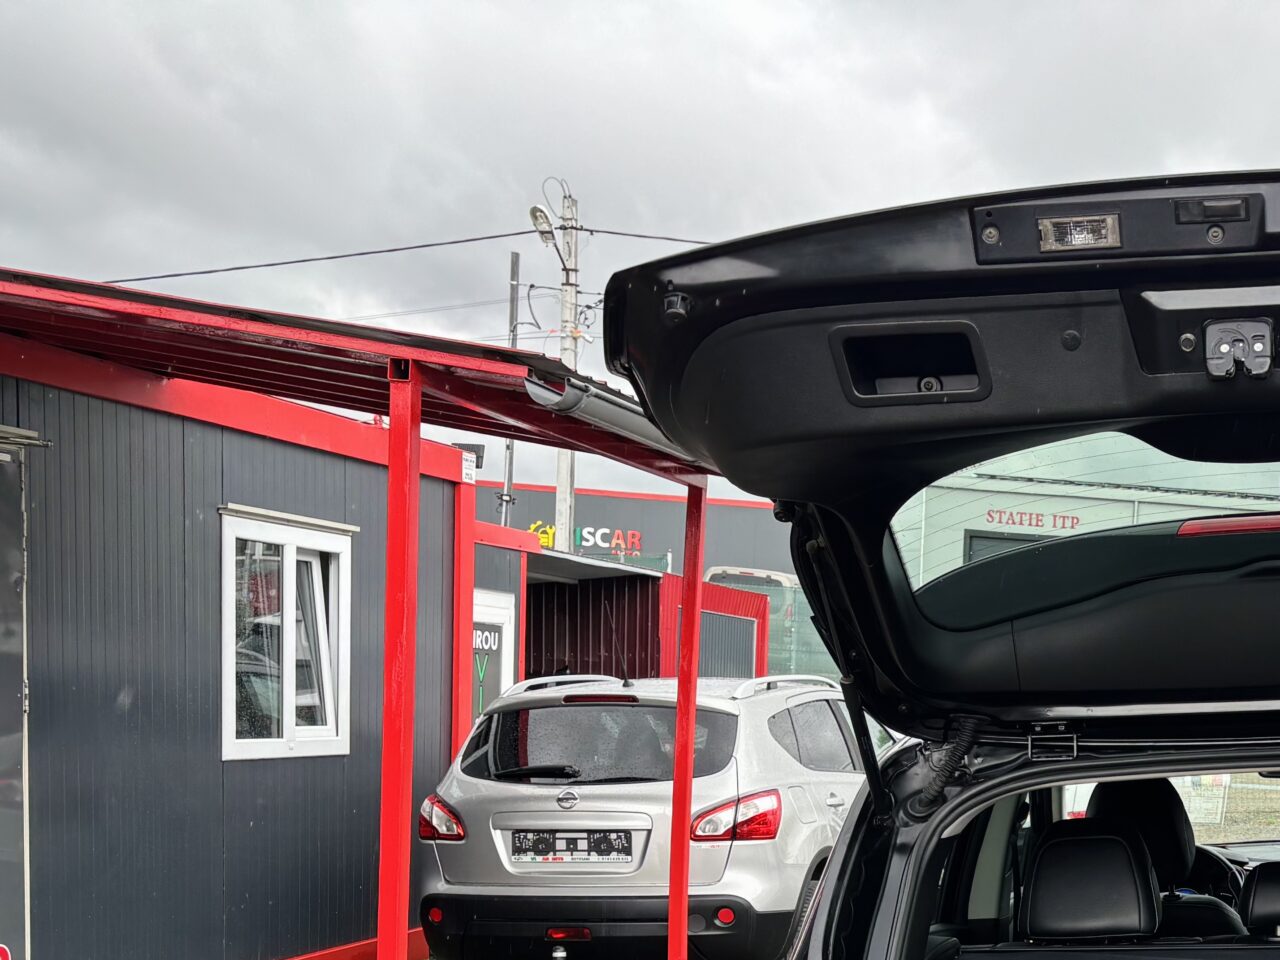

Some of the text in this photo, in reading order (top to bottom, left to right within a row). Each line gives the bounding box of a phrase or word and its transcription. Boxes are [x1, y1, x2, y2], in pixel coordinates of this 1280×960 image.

[986, 510, 1080, 529] STATIE ITP
[575, 526, 641, 550] ISCAR
[473, 629, 499, 650] IROU
